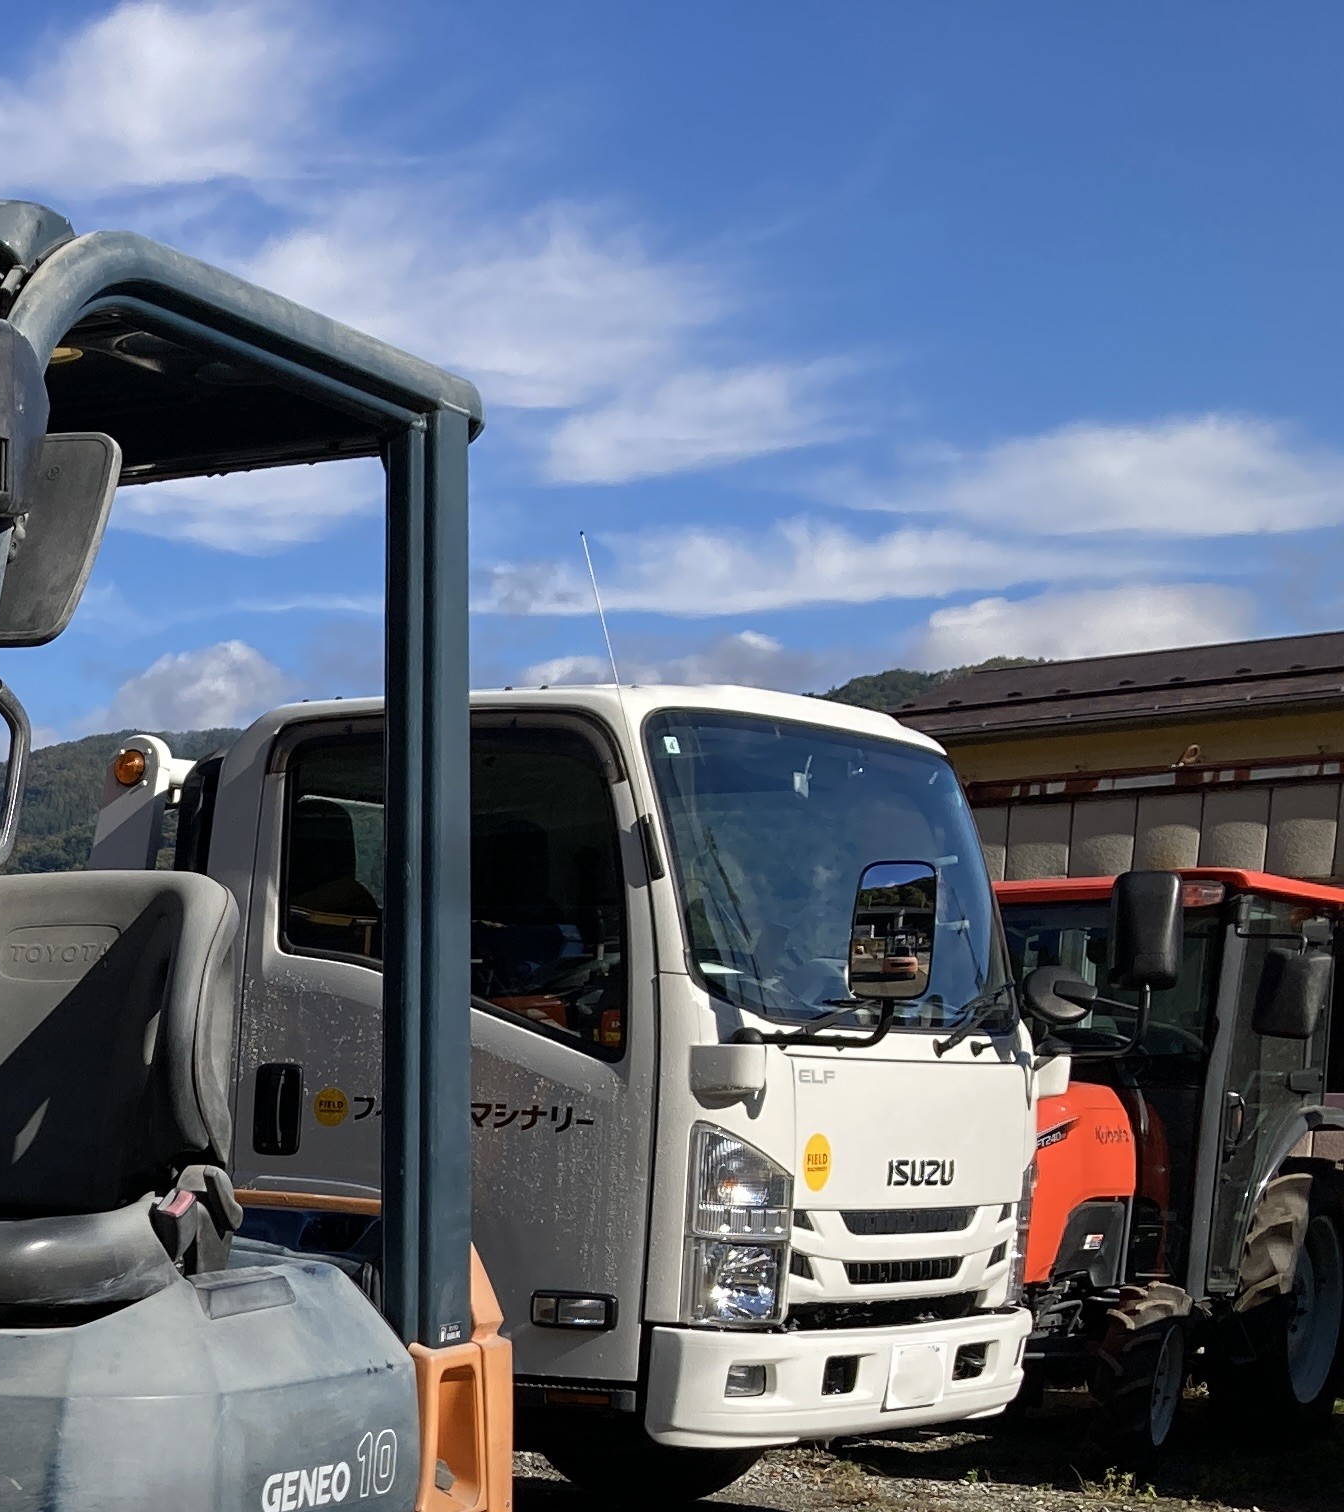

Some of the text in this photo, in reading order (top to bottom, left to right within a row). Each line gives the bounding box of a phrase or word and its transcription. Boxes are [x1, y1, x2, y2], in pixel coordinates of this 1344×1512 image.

[10, 942, 109, 965] TOYOTA
[798, 1069, 835, 1084] ELF
[319, 1100, 344, 1109] FIELD
[807, 1153, 828, 1165] FIELD
[886, 1159, 955, 1187] ISUZU
[357, 1428, 398, 1498] 10
